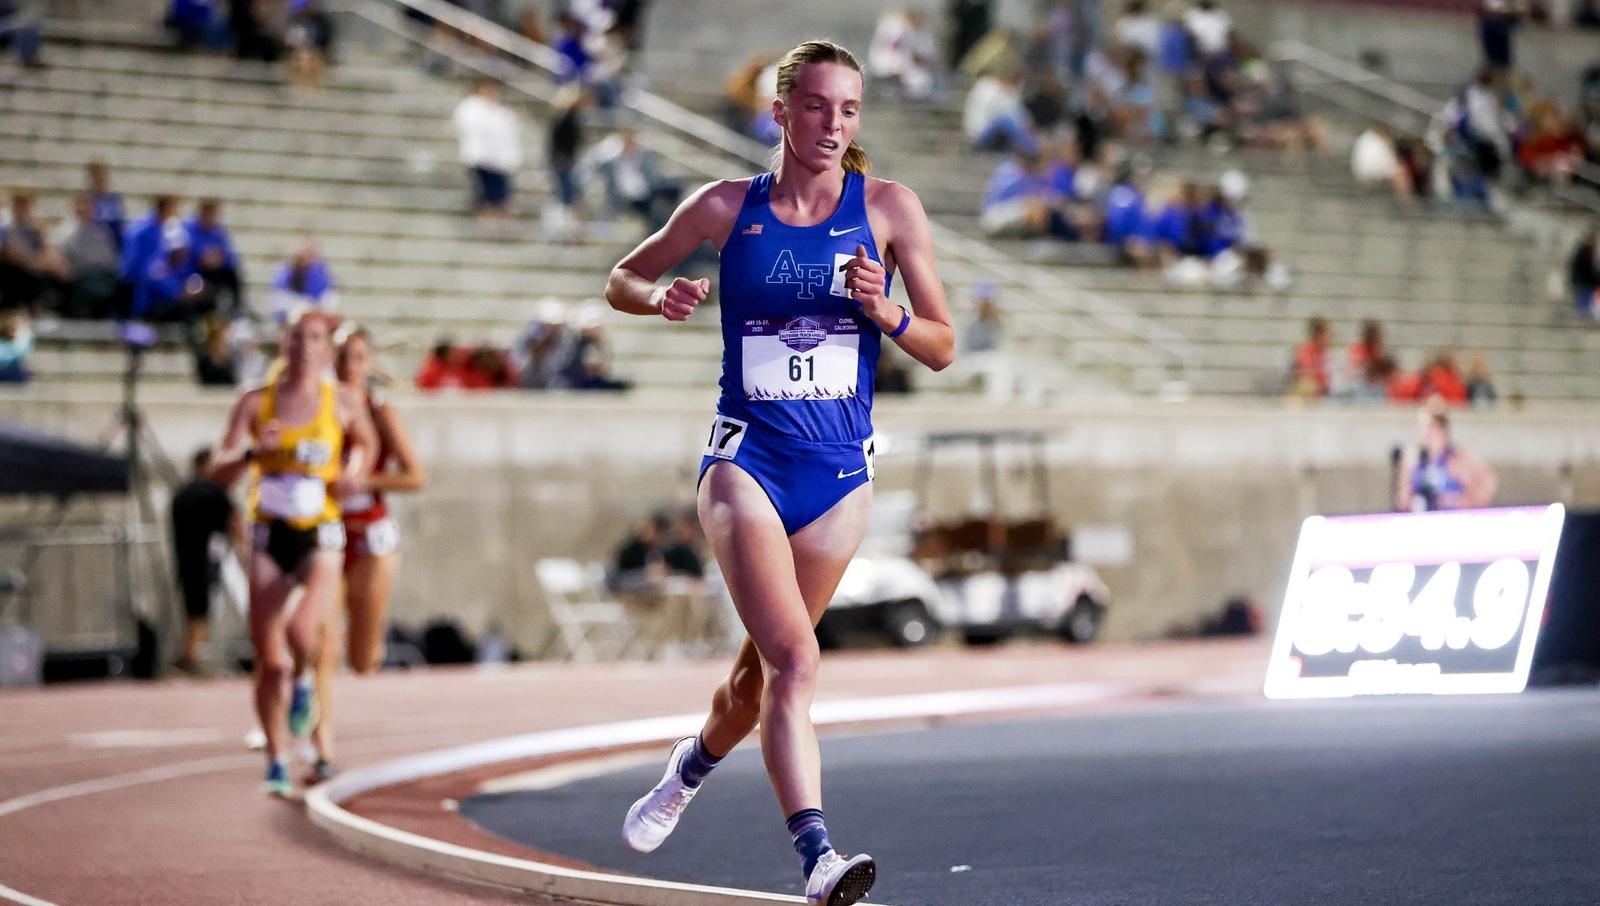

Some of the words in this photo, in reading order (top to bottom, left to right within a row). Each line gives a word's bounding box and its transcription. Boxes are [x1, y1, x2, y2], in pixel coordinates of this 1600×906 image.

[766, 249, 830, 299] AF
[788, 355, 814, 382] 61
[708, 419, 743, 449] 17
